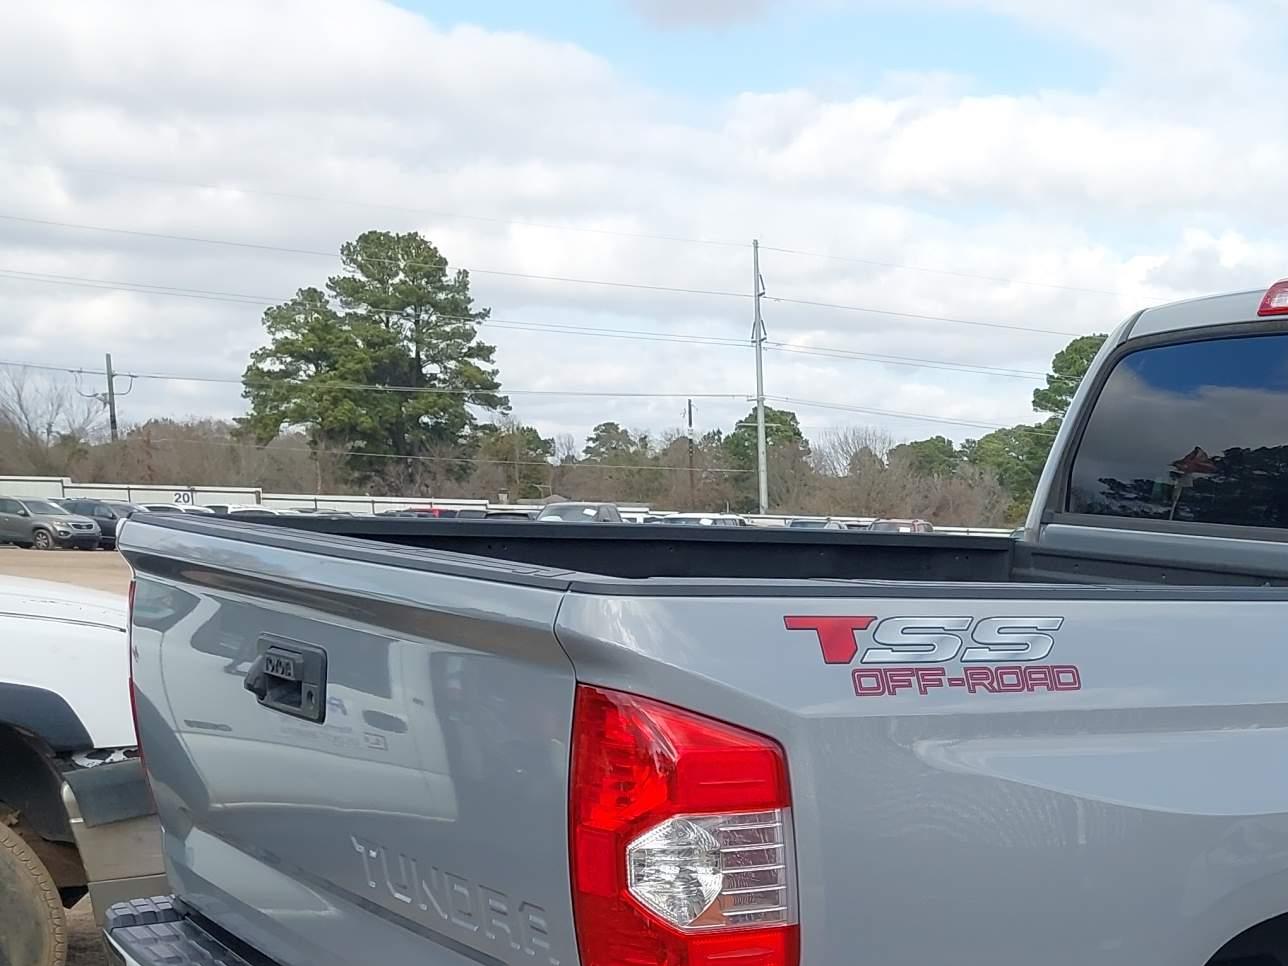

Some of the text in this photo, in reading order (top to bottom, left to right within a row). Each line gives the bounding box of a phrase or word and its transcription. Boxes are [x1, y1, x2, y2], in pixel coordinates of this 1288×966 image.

[174, 492, 190, 504] 20
[783, 615, 1064, 665] TSS
[851, 665, 1082, 697] OFF-ROAD
[351, 835, 561, 966] TUNDRA
